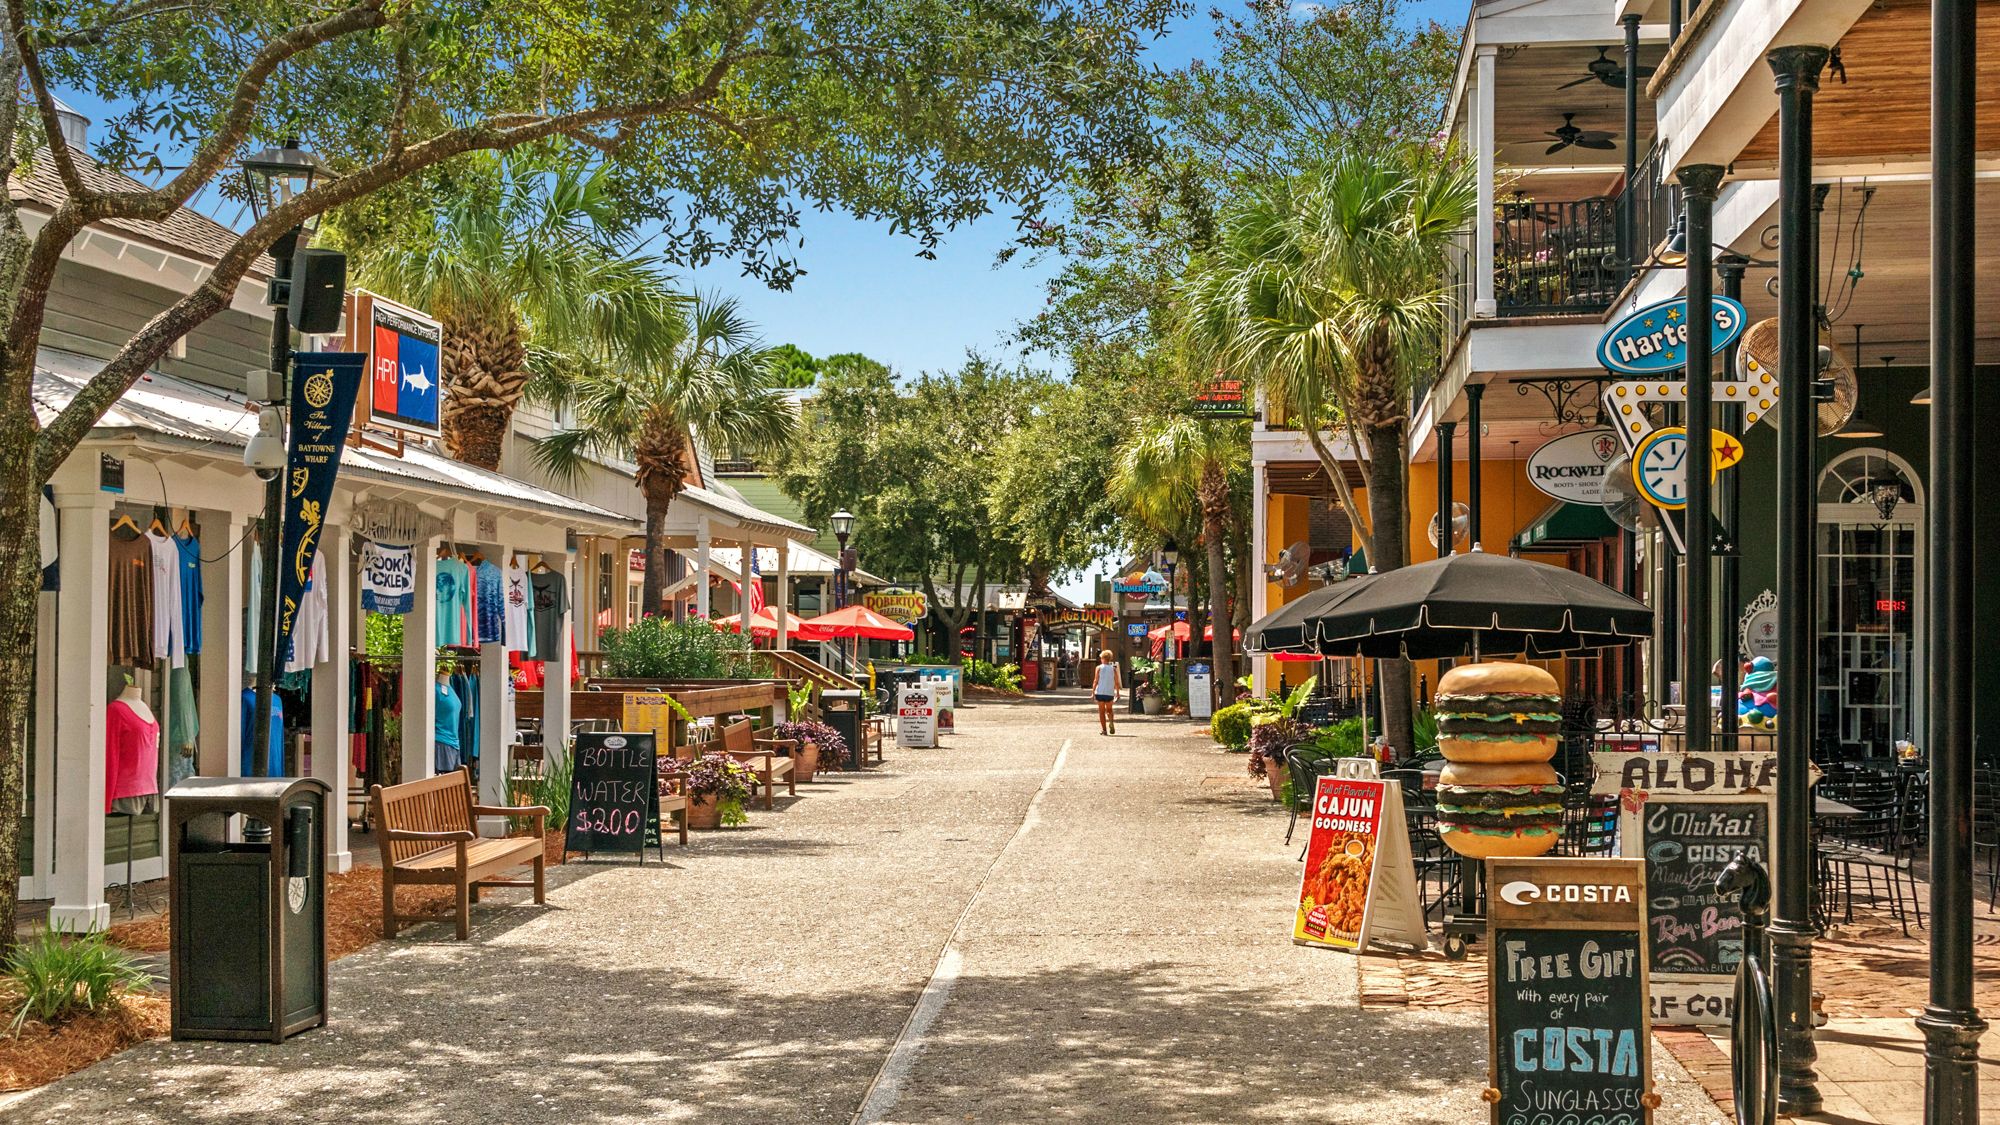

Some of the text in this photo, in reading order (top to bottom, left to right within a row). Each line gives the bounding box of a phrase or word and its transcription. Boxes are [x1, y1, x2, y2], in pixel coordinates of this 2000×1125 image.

[375, 311, 439, 342] HIGH PERFORMANCE OFFSHORE
[376, 356, 397, 385] HPO
[309, 411, 327, 419] The
[303, 421, 331, 430] Village
[312, 430, 325, 442] of
[298, 444, 336, 453] BAYTOWNE
[304, 455, 329, 463] WHARF
[1080, 609, 1114, 631] DOOR
[904, 709, 928, 717] OPEN
[581, 747, 650, 769] BOTTLE
[576, 780, 646, 805] WATER
[1320, 782, 1377, 798] Full of Flavorful
[1318, 795, 1375, 819] CAJUN
[1315, 817, 1373, 834] GOODNESS
[1546, 885, 1631, 903] COSTA
[1506, 940, 1635, 982] FREE GIFT
[1549, 991, 1580, 1012] every
[1549, 1007, 1564, 1020] of
[1513, 1026, 1639, 1077] COSTA
[1513, 1080, 1642, 1113] SUNGLASSES
